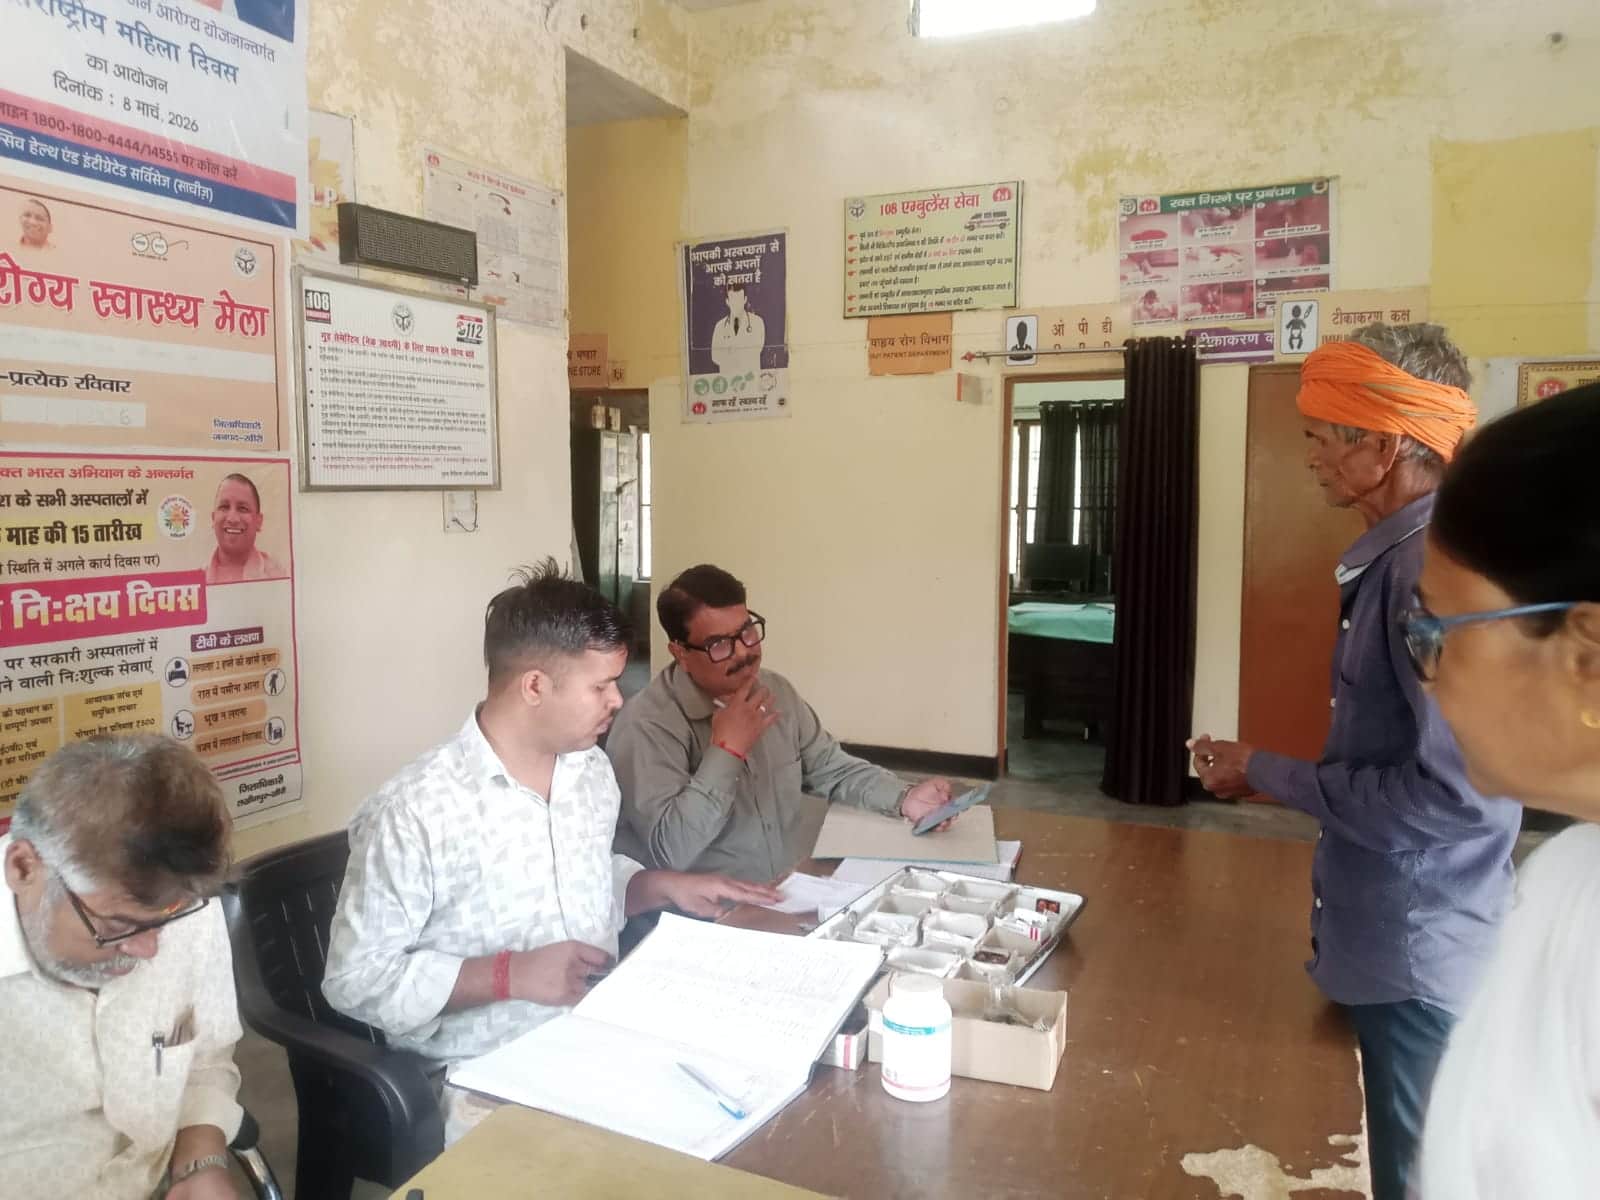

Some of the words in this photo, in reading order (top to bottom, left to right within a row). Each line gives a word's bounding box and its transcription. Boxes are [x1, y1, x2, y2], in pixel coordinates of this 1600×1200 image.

[156, 4, 200, 31] आरोग्य
[116, 20, 180, 64] महिला
[189, 43, 239, 85] दिवस
[85, 53, 108, 74] का
[113, 62, 168, 94] आयोजन
[52, 70, 103, 102] दिनांक
[122, 96, 131, 112] 8
[168, 112, 199, 132] 2026
[29, 136, 58, 160] हेल्थ
[62, 143, 80, 166] एंड
[880, 202, 897, 216] 108
[902, 193, 950, 220] एम्बुलेंस
[955, 191, 979, 208] सेवा
[1236, 190, 1252, 203] पर
[692, 246, 720, 262] आपकी
[724, 243, 766, 258] अस्वच्छता
[770, 240, 780, 252] से
[706, 258, 732, 273] आपके
[735, 256, 761, 270] अपनों
[714, 274, 726, 286] को
[728, 272, 752, 285] खतरा
[755, 269, 762, 283] है
[90, 281, 204, 329] स्वास्थ्य
[214, 290, 269, 338] मेला
[306, 291, 330, 311] 108
[1078, 318, 1088, 336] पी
[1102, 316, 1112, 334] डी
[1333, 307, 1383, 325] टीकाकरण
[1390, 309, 1411, 323] कक्ष
[467, 323, 483, 340] 112
[899, 334, 916, 346] रोग
[921, 332, 950, 344] विभाग
[75, 374, 130, 392] रविवार
[28, 466, 64, 478] भारत
[68, 464, 124, 478] अभियान
[128, 466, 140, 478] के
[16, 489, 31, 506] के
[36, 488, 65, 506] सभी
[70, 488, 132, 506] अस्पतालों
[135, 488, 149, 506] में
[6, 525, 40, 546] माह
[44, 520, 68, 544] की
[73, 524, 89, 544] 15
[94, 519, 142, 541] तारीख
[8, 557, 40, 576] स्थिति
[43, 556, 53, 573] में
[57, 556, 85, 572] अगले
[89, 555, 111, 570] कार्य
[114, 554, 140, 568] दिवस
[144, 553, 160, 568] पर)
[127, 580, 201, 617] दिवस
[4, 657, 24, 670] पर
[30, 649, 81, 668] सरकारी
[87, 640, 145, 661] अस्पतालों
[149, 638, 158, 654] में
[18, 671, 54, 688] वाली
[118, 658, 154, 677] सेवाएं
